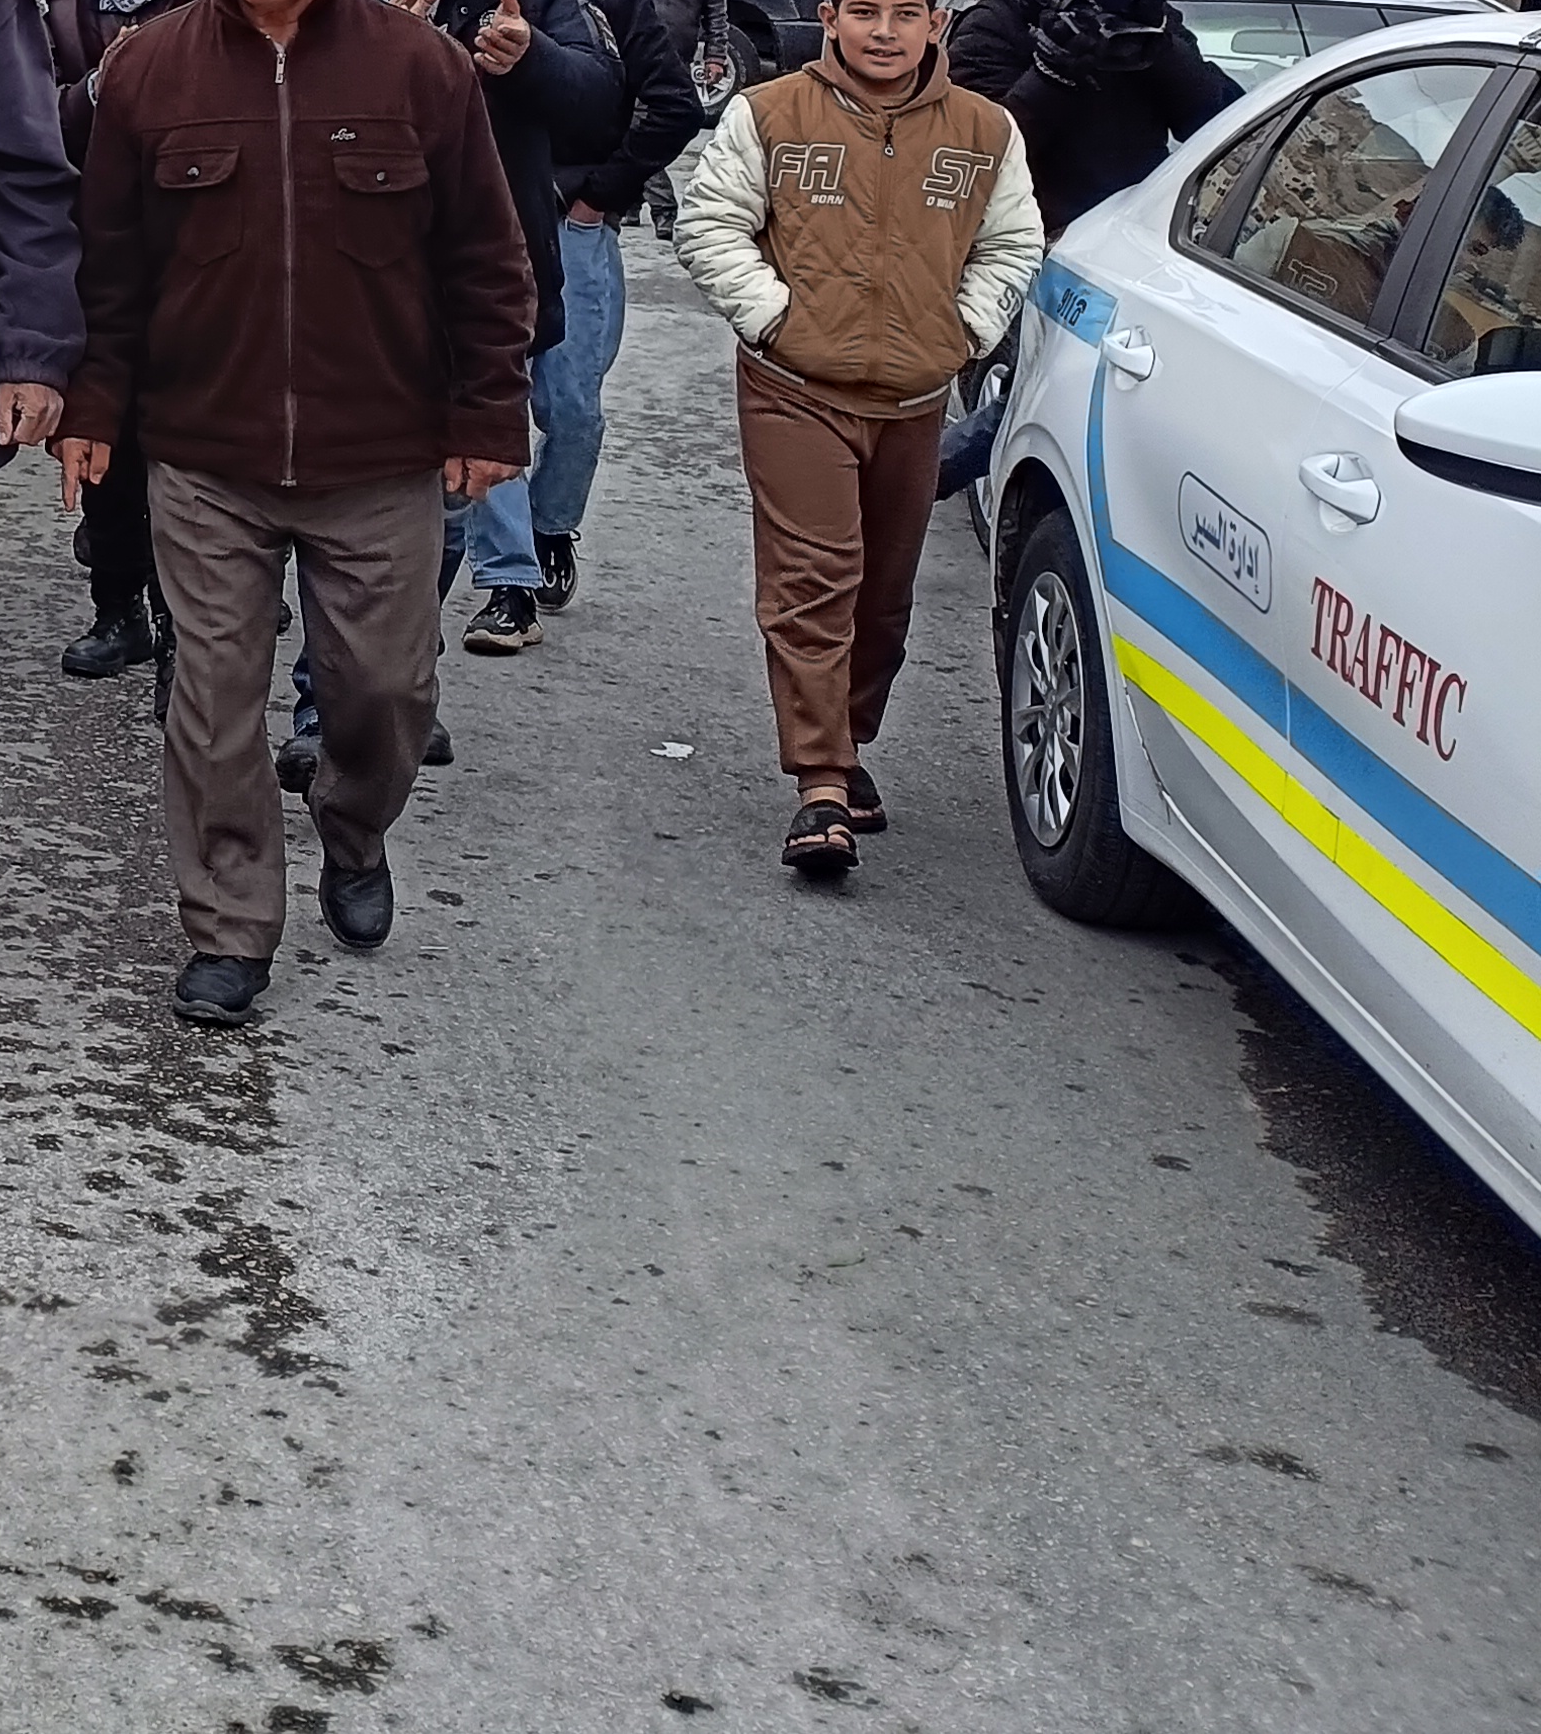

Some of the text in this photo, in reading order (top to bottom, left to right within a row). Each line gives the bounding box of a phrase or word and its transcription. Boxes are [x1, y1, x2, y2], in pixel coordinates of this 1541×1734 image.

[811, 194, 845, 206] BORN
[1057, 287, 1079, 321] 911
[1190, 510, 1261, 595] إدارة السير
[1311, 576, 1468, 762] TRAFFIC
